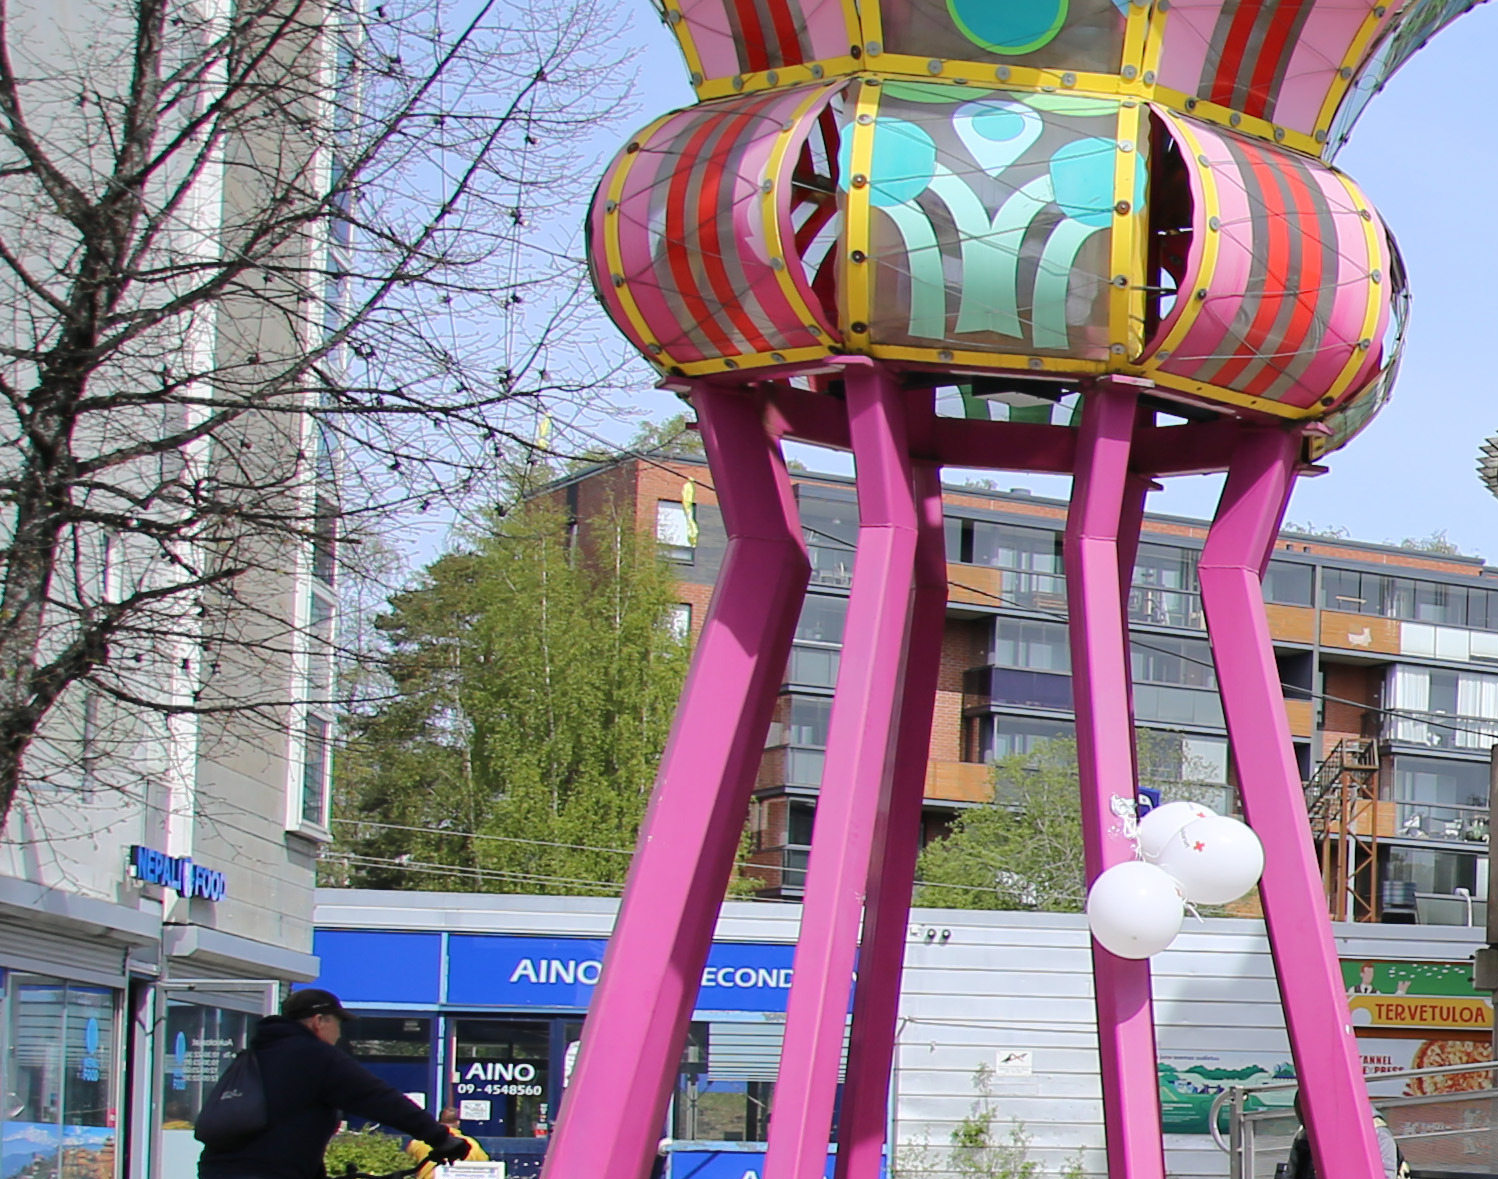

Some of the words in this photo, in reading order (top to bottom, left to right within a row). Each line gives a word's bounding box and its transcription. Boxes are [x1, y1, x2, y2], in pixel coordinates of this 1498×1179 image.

[195, 864, 227, 901] FOOD
[510, 957, 602, 985] AINO
[700, 966, 794, 988] ECOND
[1375, 1003, 1486, 1024] TERVETULOA
[465, 1062, 535, 1081] AINO
